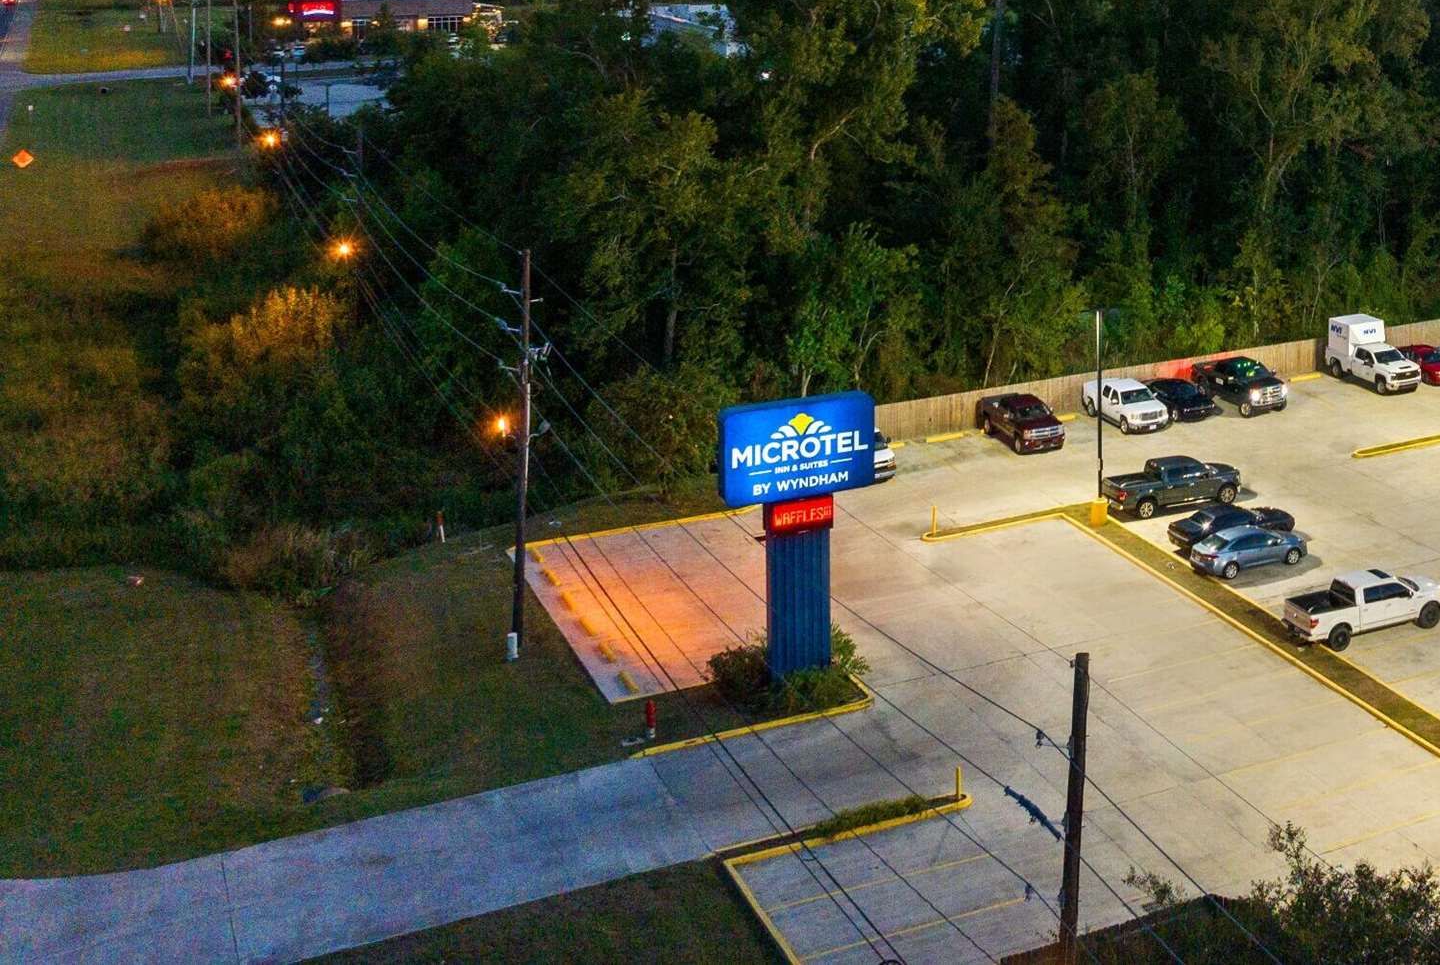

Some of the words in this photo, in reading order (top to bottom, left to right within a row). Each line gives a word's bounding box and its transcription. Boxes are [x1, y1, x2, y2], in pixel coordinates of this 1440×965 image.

[731, 430, 868, 469] MICROTEL
[775, 466, 790, 474] INN
[799, 460, 829, 470] SUITES
[753, 482, 771, 496] BY
[777, 471, 848, 492] WYNDHAM
